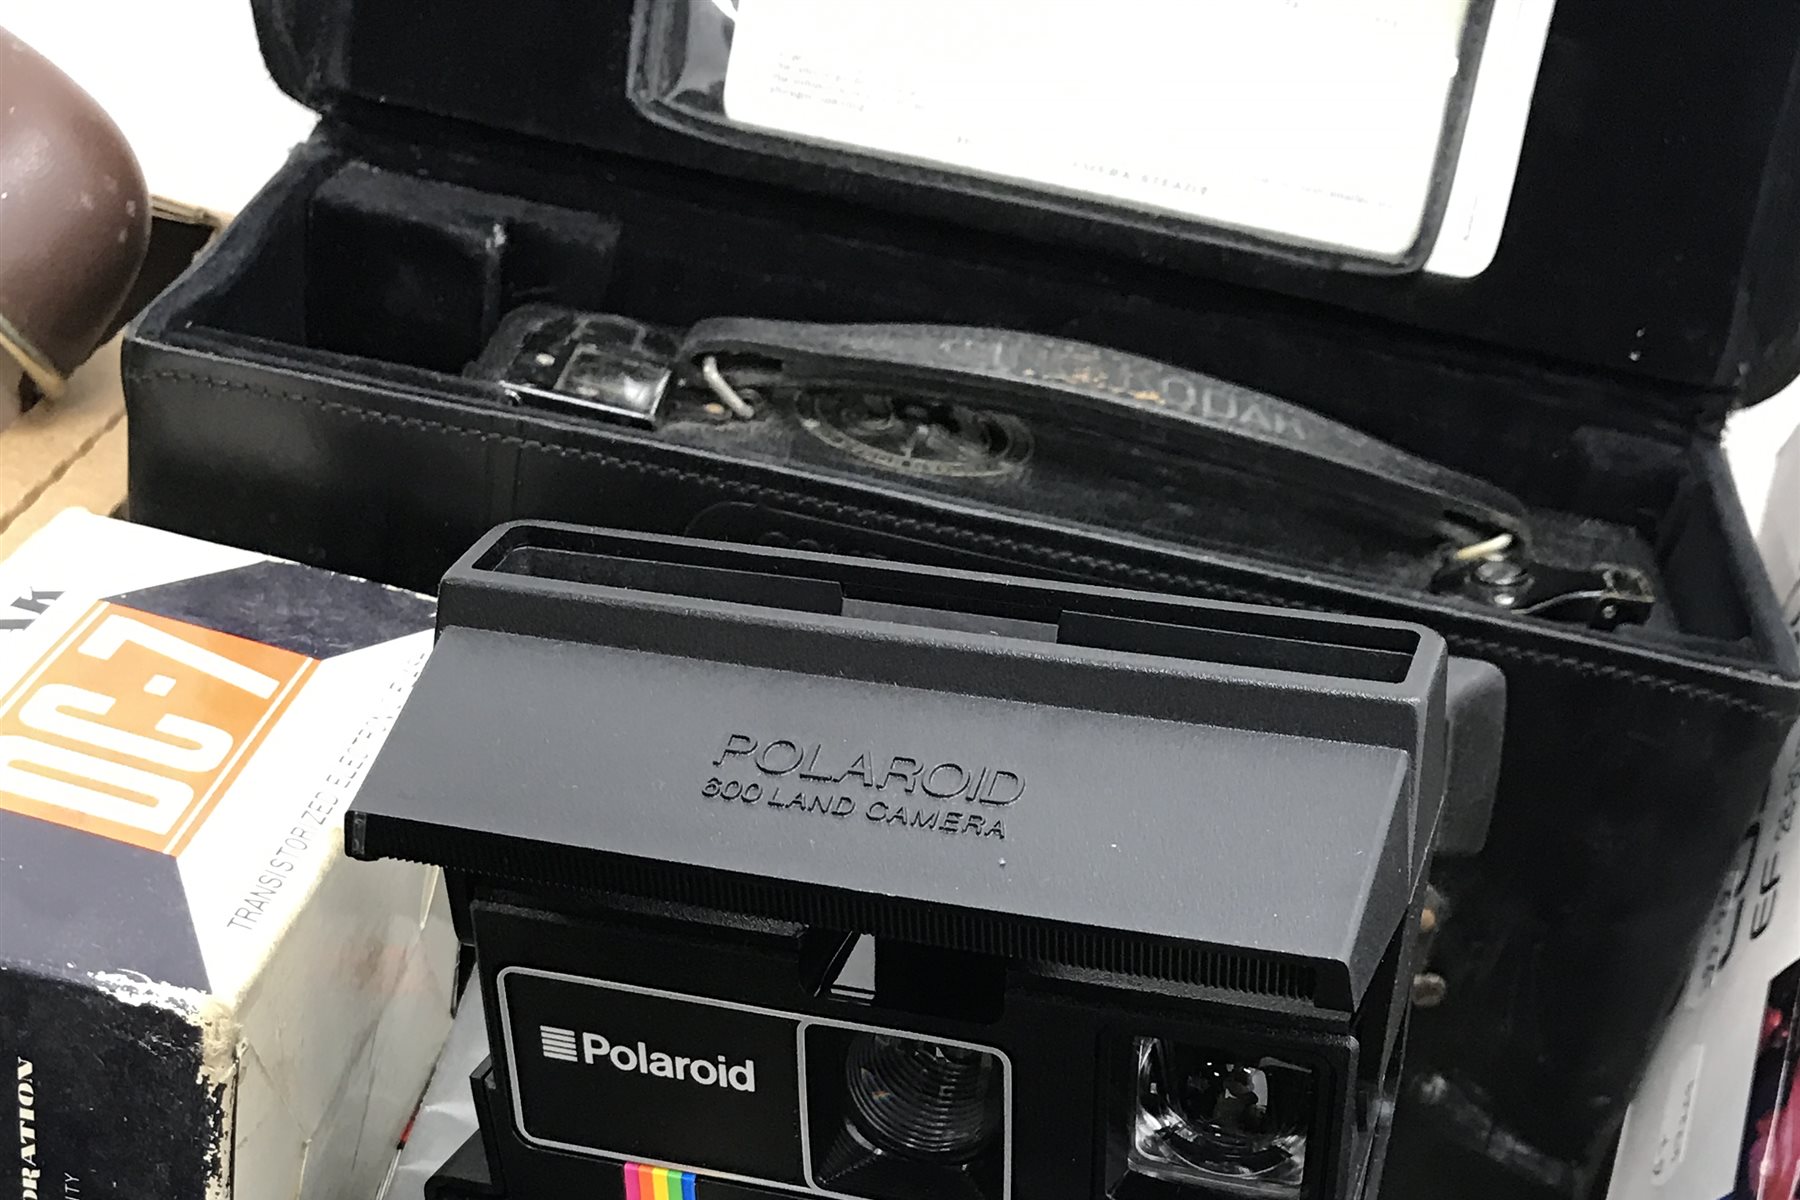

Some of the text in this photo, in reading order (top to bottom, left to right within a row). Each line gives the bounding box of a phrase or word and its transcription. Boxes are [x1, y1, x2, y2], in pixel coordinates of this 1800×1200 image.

[0, 613, 281, 836] DC-7
[712, 734, 1026, 807] POLAROID
[701, 777, 1007, 840] 600 LAND CAMERA
[226, 790, 340, 931] TRANSISTORIZED
[582, 1031, 756, 1093] Polaroid
